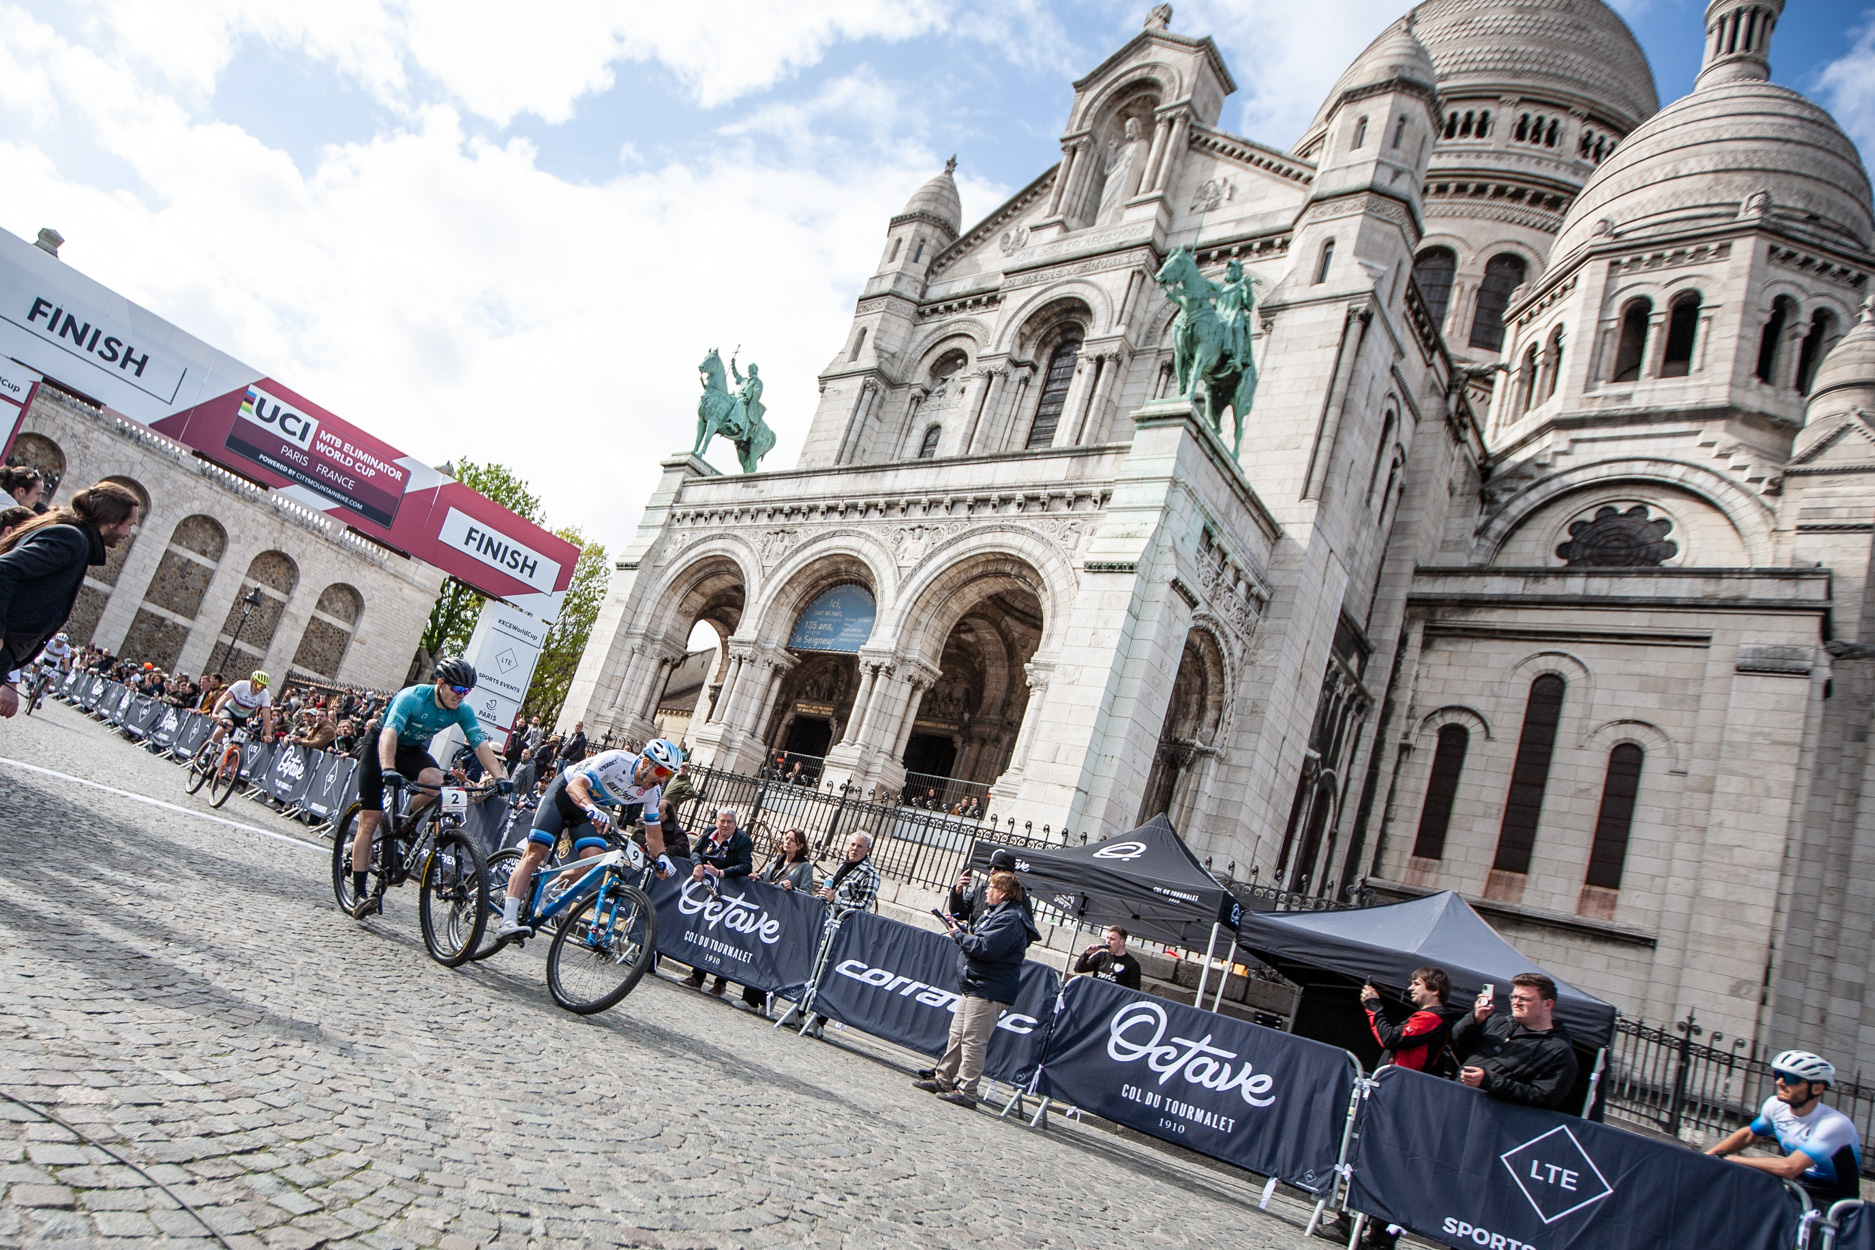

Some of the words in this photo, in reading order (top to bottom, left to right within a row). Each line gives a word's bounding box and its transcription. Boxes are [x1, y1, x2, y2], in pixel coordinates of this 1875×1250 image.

[27, 296, 149, 378] FINISH
[255, 397, 311, 442] UCI
[280, 445, 309, 467] PARIS
[315, 440, 354, 467] WORLD
[354, 462, 376, 478] CUP
[319, 429, 343, 449] MTB
[344, 443, 403, 481] ELIMINATOR
[258, 453, 288, 472] POWERED
[287, 467, 296, 477] BY
[296, 472, 363, 510] CITYMOUNTAINBIKE.COM
[315, 463, 356, 490] FRANCE
[463, 526, 539, 579] FINISH
[497, 619, 538, 640] #XCEWorldCup
[795, 635, 802, 643] le
[803, 635, 835, 646] Seigneur
[804, 620, 818, 630] 135
[818, 623, 833, 631] ans,
[501, 657, 513, 666] LTE
[478, 672, 500, 685] SPORTS
[499, 681, 520, 693] EVENTS
[277, 745, 305, 780] Octave
[451, 793, 460, 804] 2
[403, 821, 434, 870] ORBEA
[632, 850, 640, 861] 9
[678, 870, 780, 944] Octave
[684, 930, 697, 944] COL
[698, 936, 708, 948] DU
[710, 938, 753, 964] TOURMALET
[704, 953, 721, 965] 1910
[835, 959, 1038, 1035] corratc
[1107, 1001, 1276, 1107] Octave
[1121, 1083, 1142, 1103] COL
[1145, 1091, 1161, 1109] DU
[1164, 1097, 1235, 1133] TOURMALET
[1158, 1117, 1185, 1134] 1910
[1530, 1159, 1579, 1191] LTE
